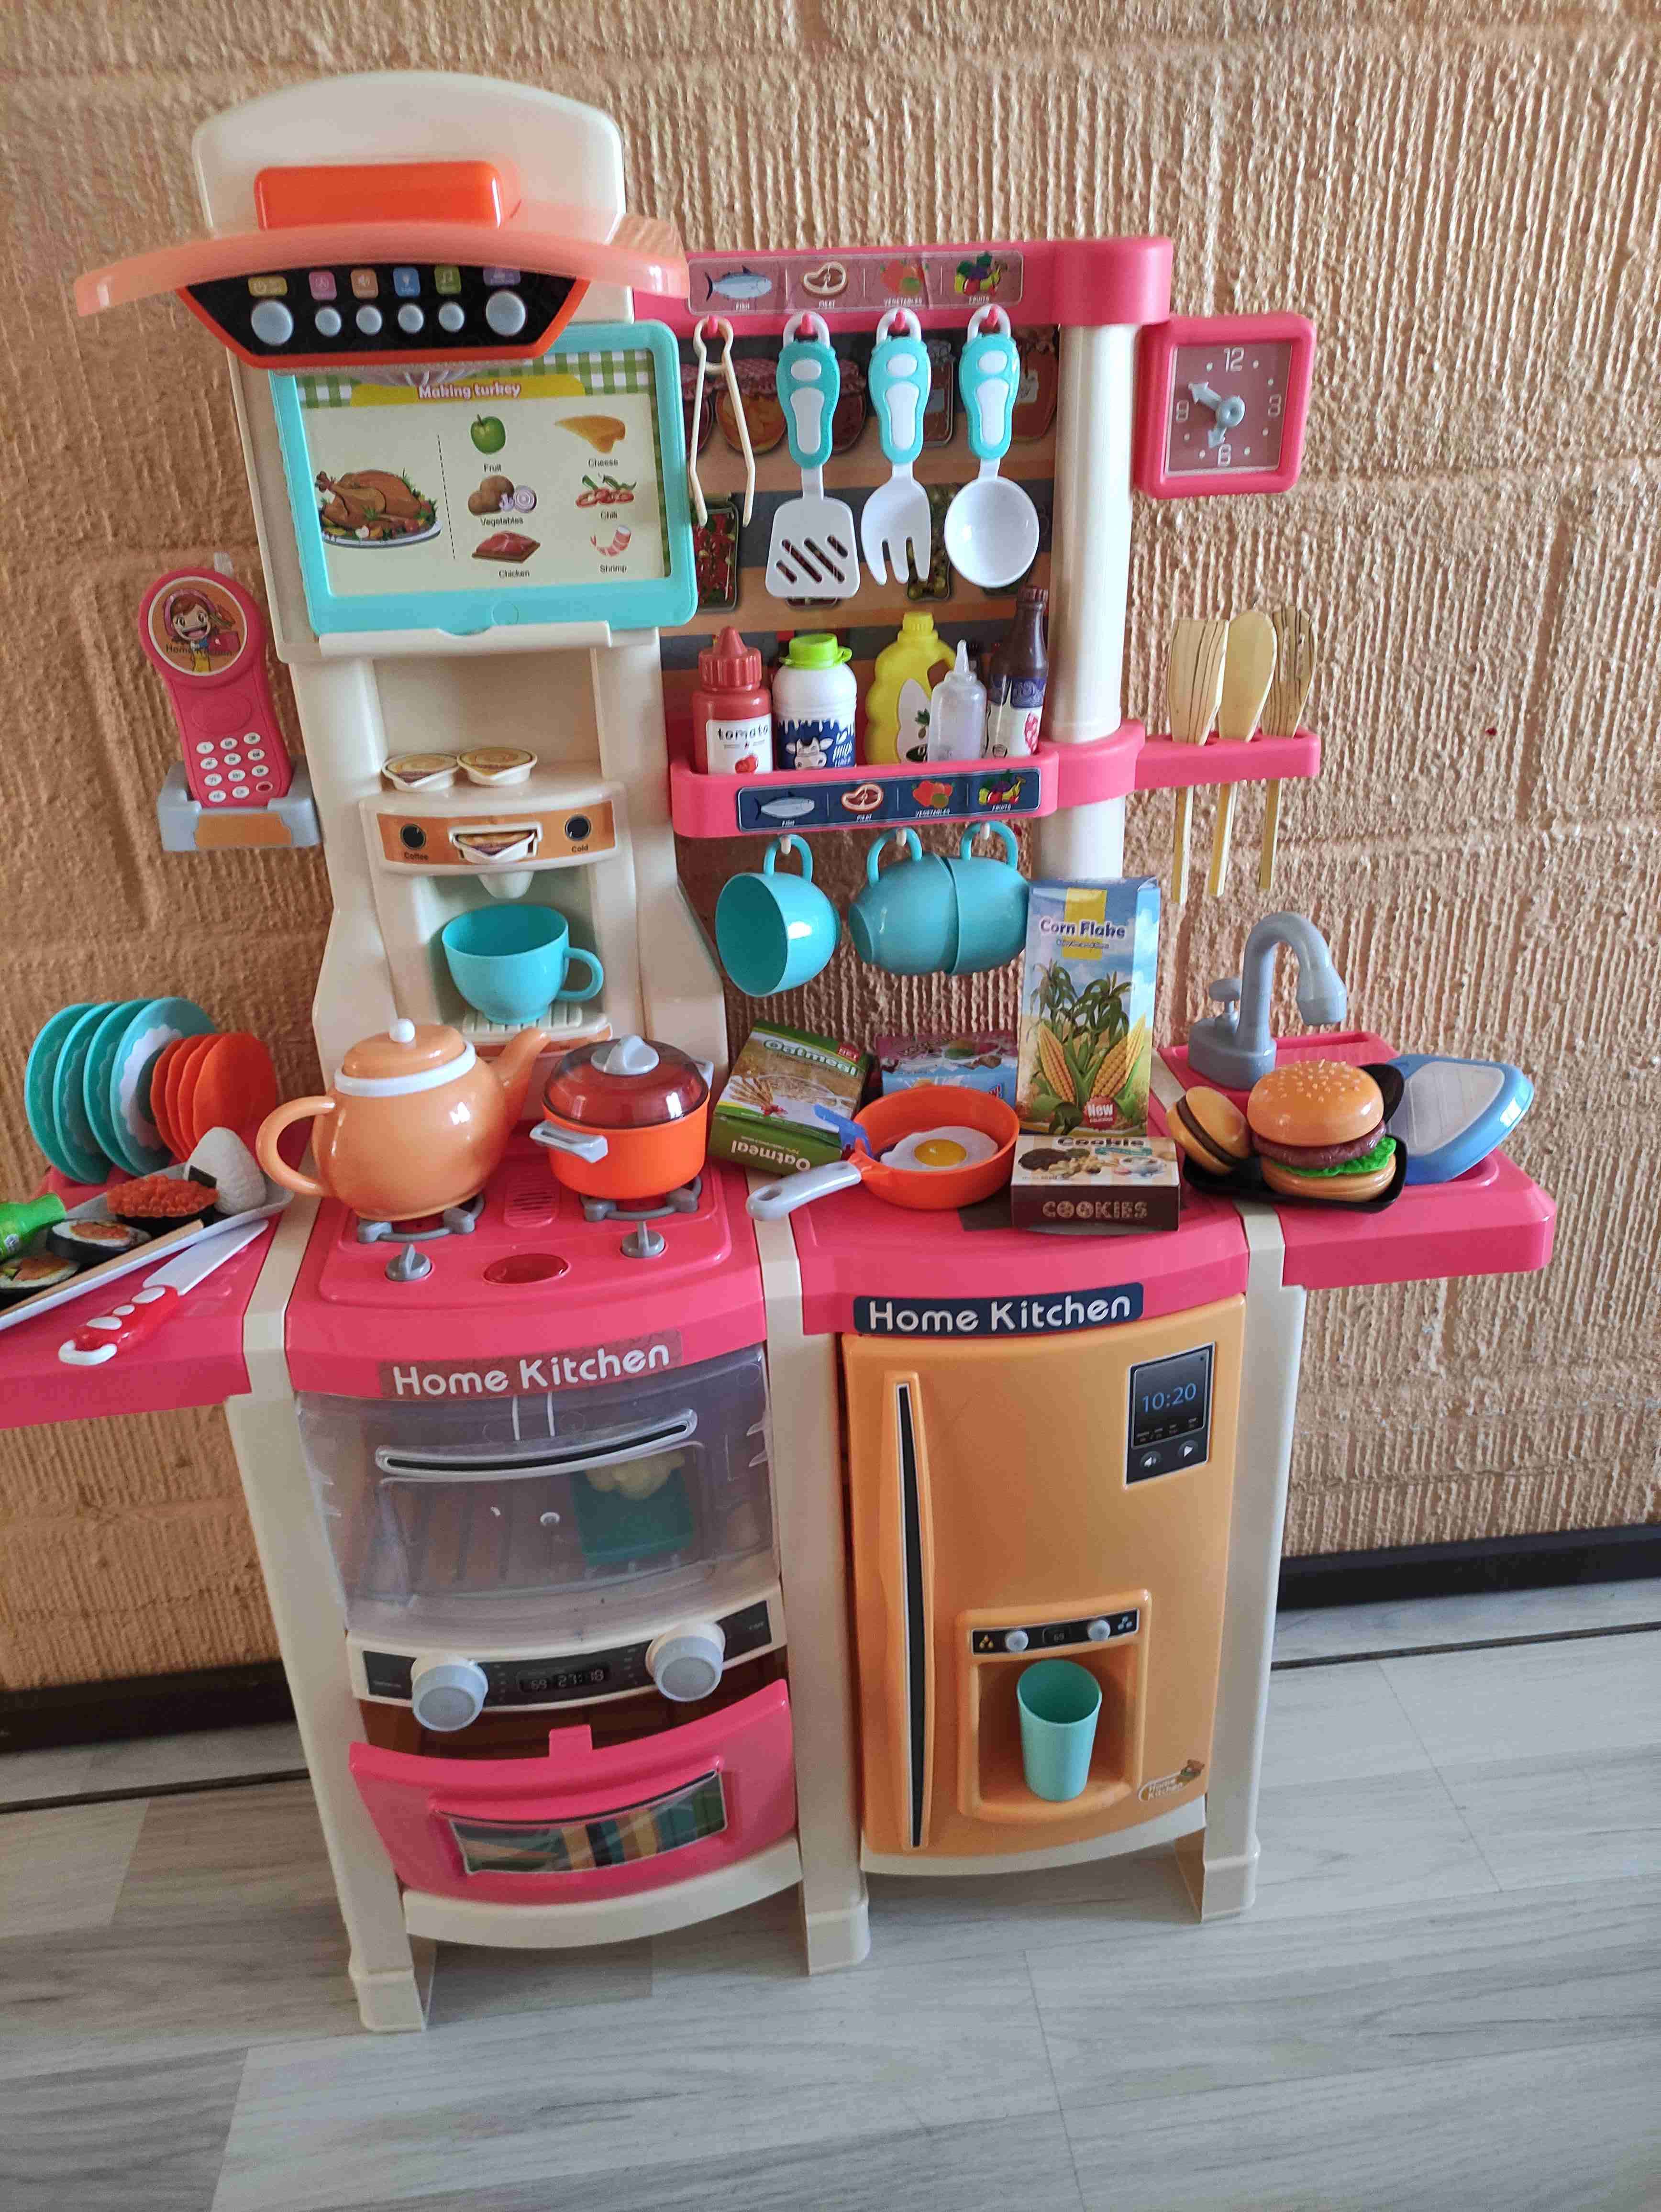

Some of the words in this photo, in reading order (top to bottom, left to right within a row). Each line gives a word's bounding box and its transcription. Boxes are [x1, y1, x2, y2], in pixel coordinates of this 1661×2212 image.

[735, 301, 750, 311] FISH
[884, 296, 923, 307] VEGETABLES
[968, 294, 990, 305] FRUITS
[1223, 346, 1245, 373] 12
[418, 384, 472, 400] Making
[473, 381, 521, 399] turkey
[1267, 394, 1282, 418] 3
[483, 463, 502, 473] Fruit
[588, 458, 619, 468] Cheese
[480, 518, 524, 528] Vegetables
[600, 510, 618, 521] Chili
[498, 569, 531, 578] Chicken
[599, 564, 628, 575] Shrimp
[717, 724, 768, 741] tomato
[404, 852, 430, 861] Coffee
[571, 845, 589, 853] Cold
[1040, 917, 1076, 936] Corn
[1080, 921, 1126, 939] Flake
[763, 1040, 858, 1077] Oatmeal
[1086, 1103, 1114, 1118] New
[731, 1139, 811, 1172] Oatmeal
[1042, 1200, 1148, 1220] COOKIES
[868, 1300, 980, 1333] Home
[990, 1294, 1131, 1331] Kitchen
[392, 1365, 509, 1396] Home
[520, 1343, 671, 1390] Kitchen
[1141, 1382, 1197, 1414] 10:20
